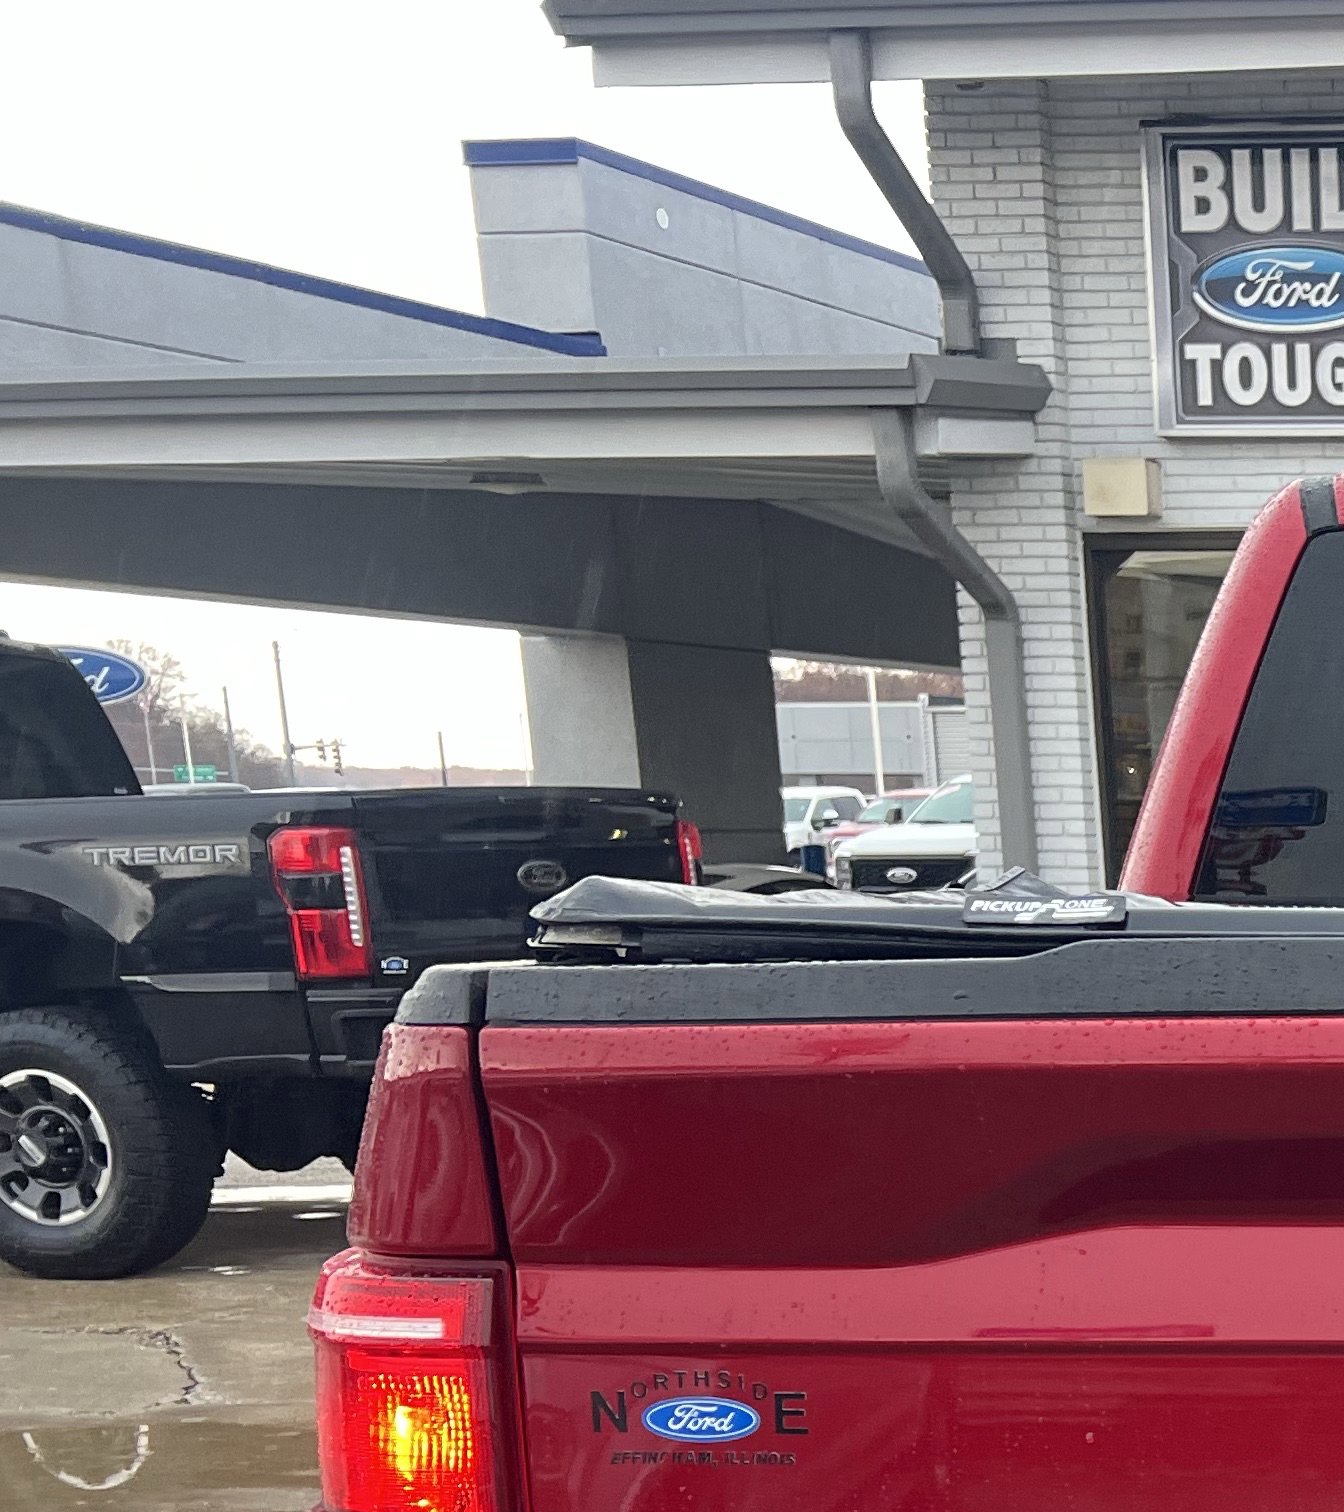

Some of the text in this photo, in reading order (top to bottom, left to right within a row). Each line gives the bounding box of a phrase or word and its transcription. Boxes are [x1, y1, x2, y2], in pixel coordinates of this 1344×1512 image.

[1233, 258, 1342, 309] Ford
[83, 844, 243, 866] TREMOR
[590, 1369, 809, 1435] NORTHSIDE
[667, 1403, 736, 1432] Ford
